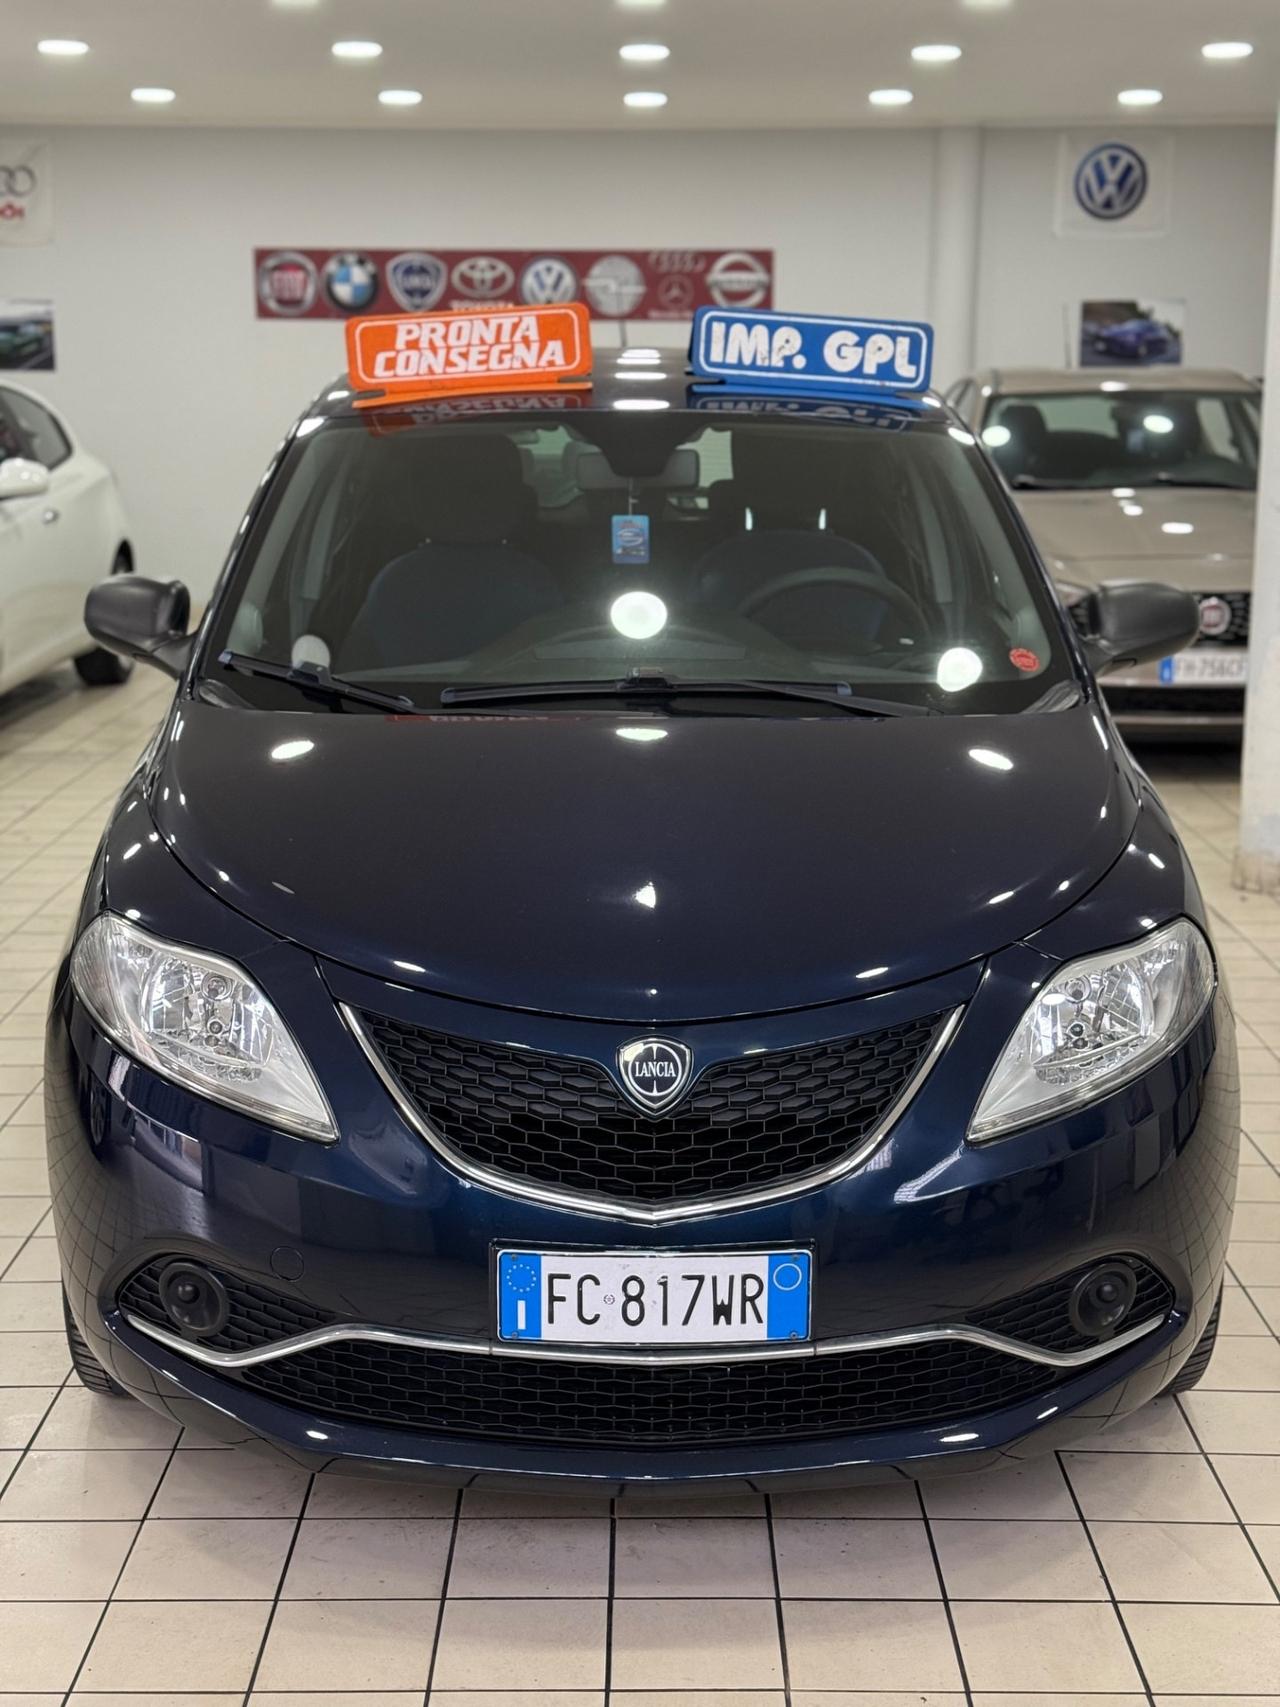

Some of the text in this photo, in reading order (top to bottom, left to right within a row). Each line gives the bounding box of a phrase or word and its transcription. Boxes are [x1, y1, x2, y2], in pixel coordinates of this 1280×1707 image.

[395, 315, 540, 350] PRONTA
[709, 320, 917, 379] IMP. GPL
[373, 340, 566, 378] CONSEGNA
[635, 1061, 677, 1078] LANCIA
[547, 1272, 764, 1327] FC 817WR
